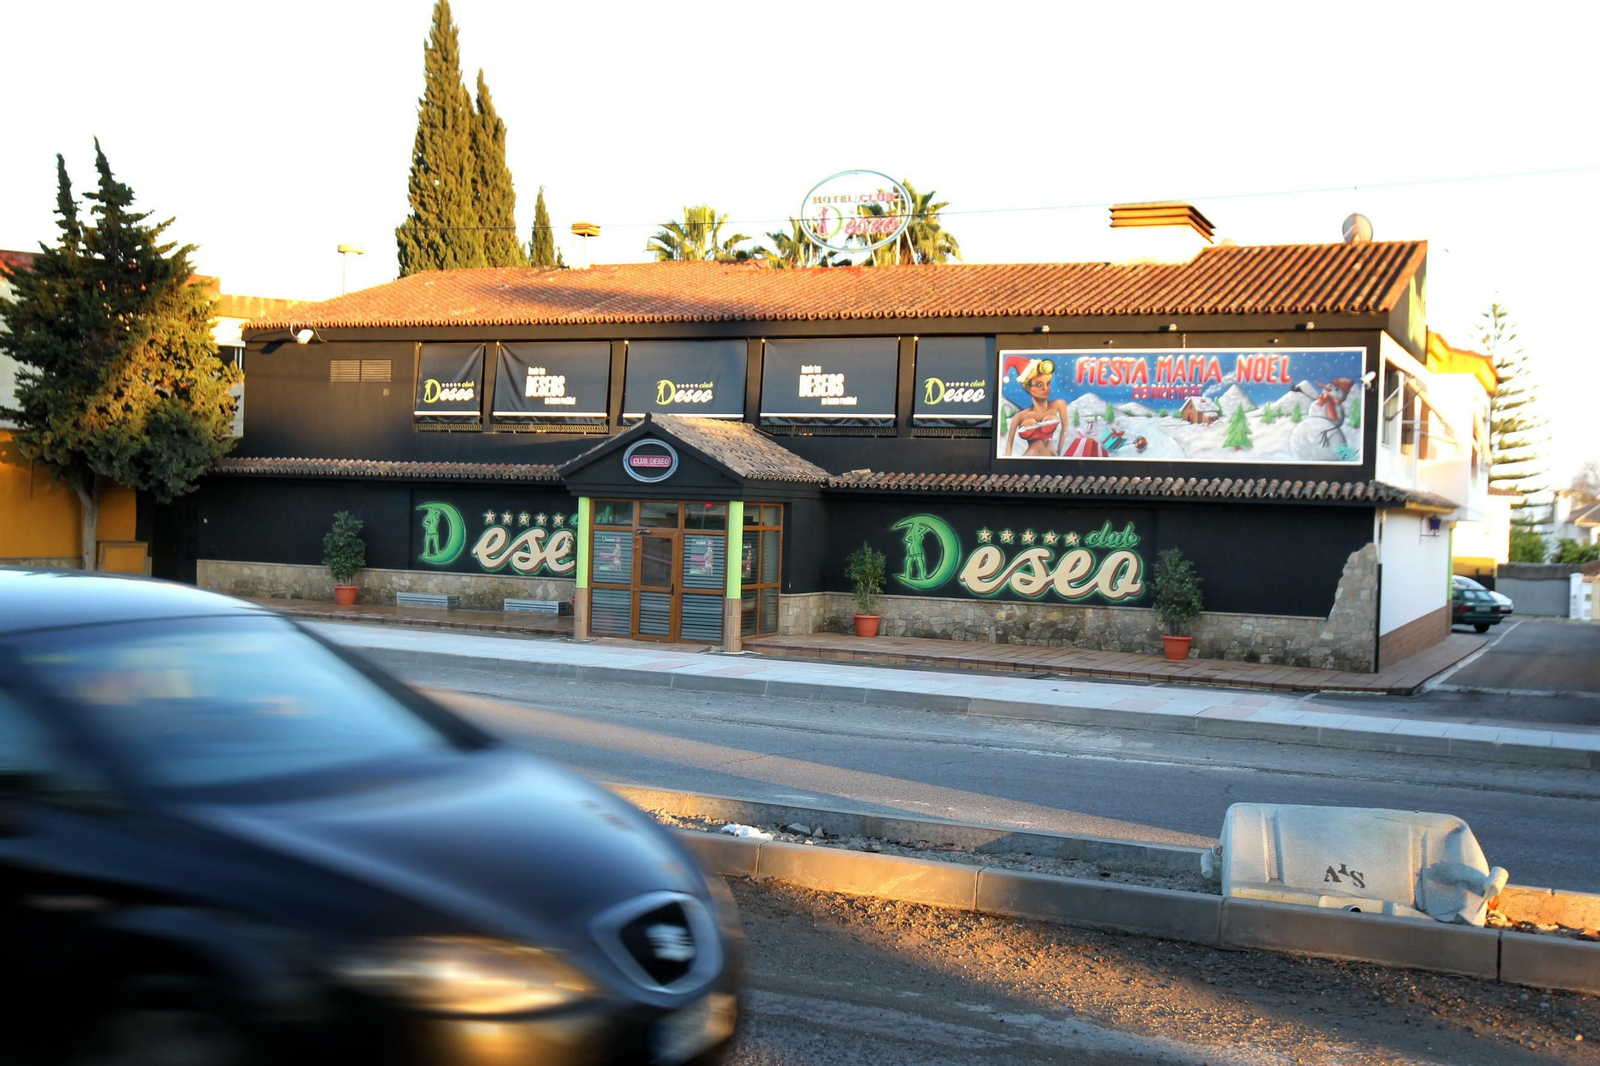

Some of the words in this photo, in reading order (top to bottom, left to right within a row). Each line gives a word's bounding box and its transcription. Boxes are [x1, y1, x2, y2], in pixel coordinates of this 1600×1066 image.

[812, 195, 853, 204] HOTEL
[858, 192, 896, 203] CLUB
[1155, 354, 1223, 384] MAMA
[1236, 353, 1293, 384] NOEL
[423, 379, 475, 404] Deseo
[525, 375, 566, 397] DESEOS
[656, 379, 714, 405] Deseo
[798, 373, 845, 398] DESEOS
[923, 377, 986, 405] Deseo
[633, 457, 649, 465] CLUB
[649, 457, 670, 465] DESEO
[1085, 521, 1141, 548] club
[890, 514, 1145, 599] Deseo
